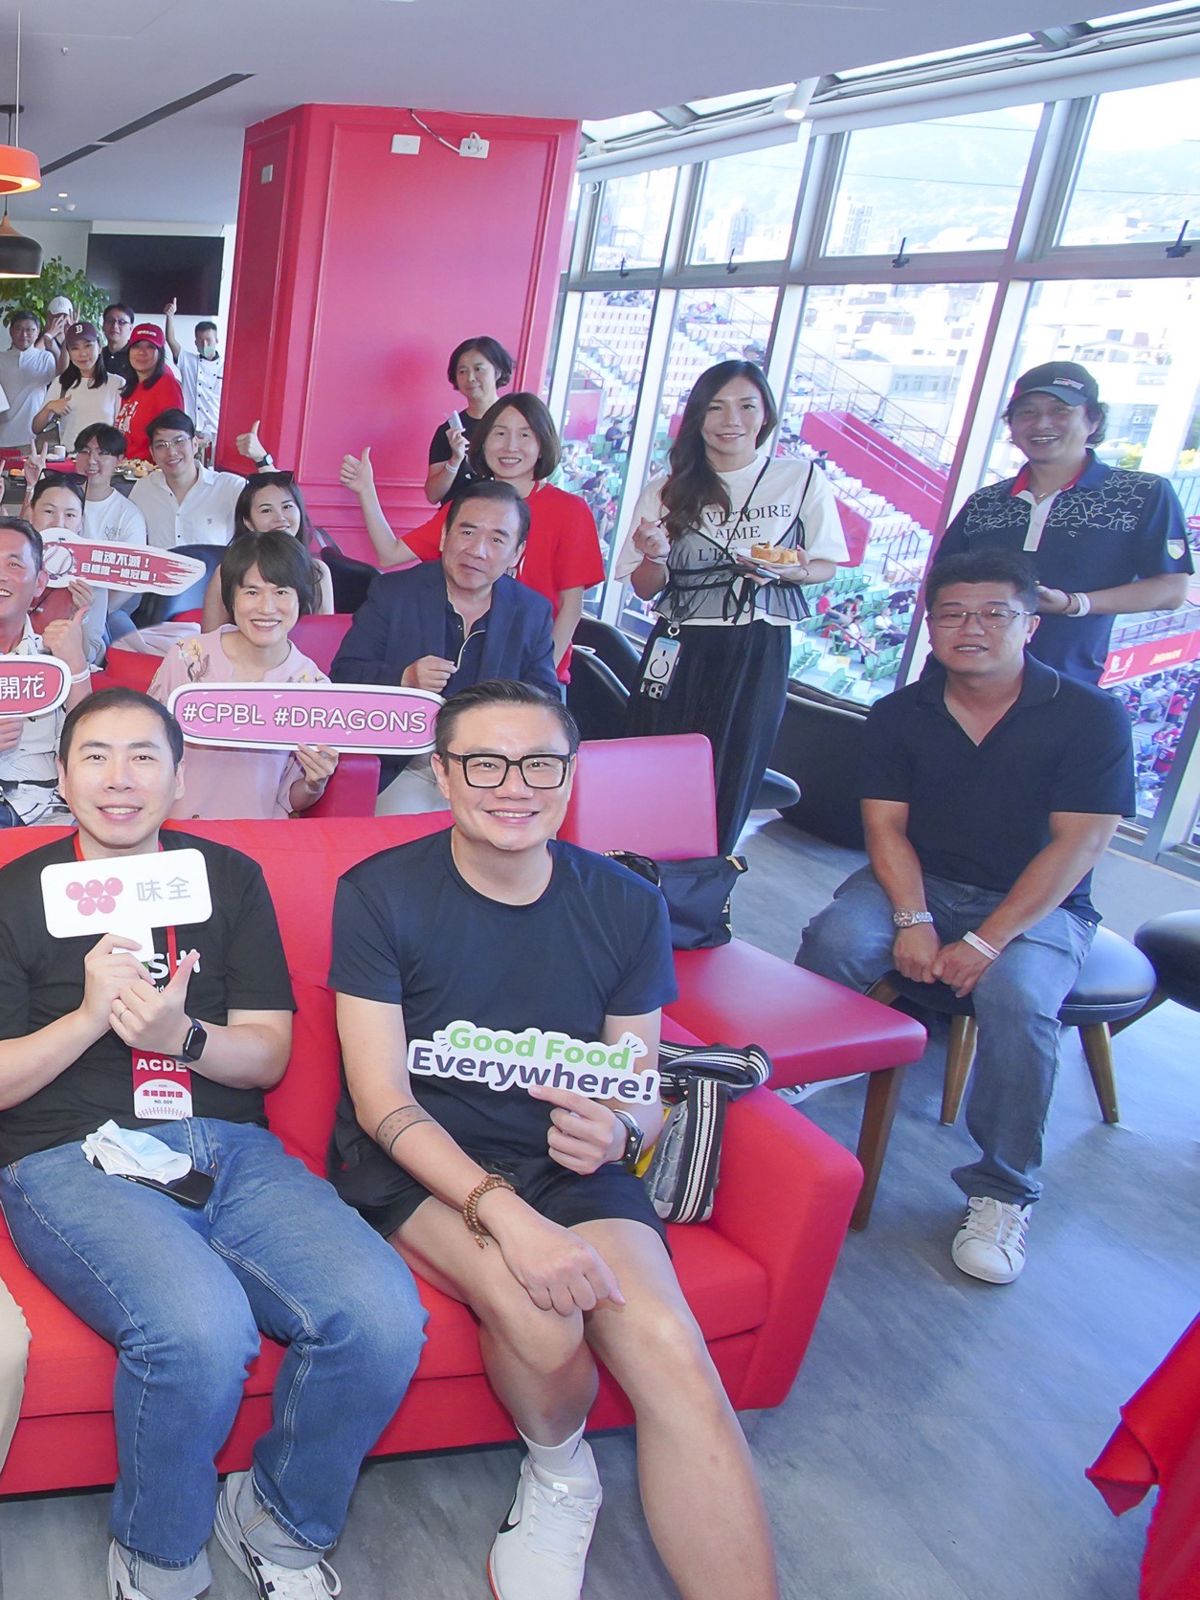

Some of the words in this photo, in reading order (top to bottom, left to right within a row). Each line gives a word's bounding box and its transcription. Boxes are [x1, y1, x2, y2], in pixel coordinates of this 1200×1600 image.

[715, 525, 761, 541] AIME
[182, 702, 265, 725] #CPBL
[273, 706, 427, 733] #DRAGONS
[136, 876, 191, 902] 味全
[449, 1027, 537, 1057] Good
[544, 1039, 631, 1070] Food
[412, 1046, 656, 1101] Everywhere!
